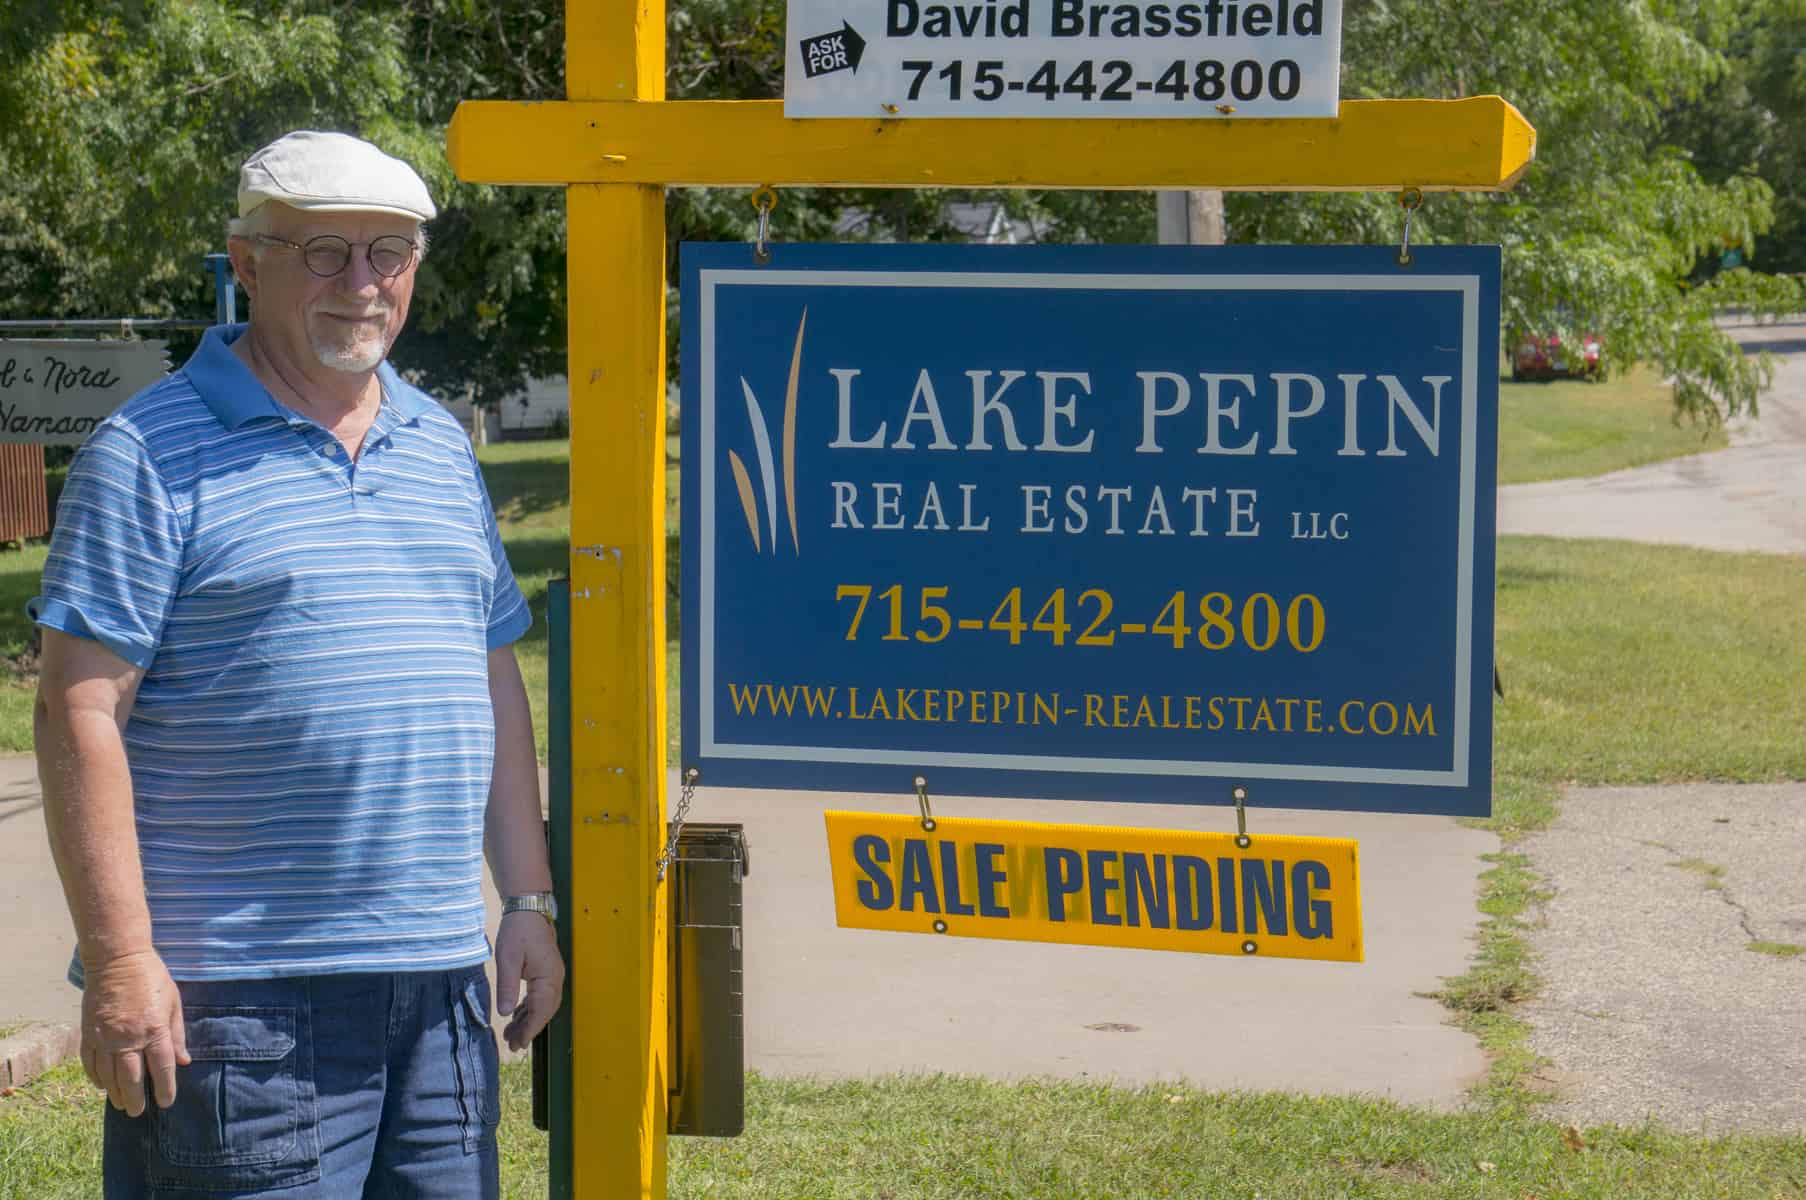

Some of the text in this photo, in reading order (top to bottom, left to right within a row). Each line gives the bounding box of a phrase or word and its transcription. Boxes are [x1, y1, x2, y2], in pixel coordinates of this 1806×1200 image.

[808, 35, 846, 58] ASK
[887, 0, 1323, 38] David Brassfield
[810, 51, 848, 73] FOR
[902, 60, 1300, 101] 715-442-4800
[828, 368, 1453, 457] LAKE PEPIN
[831, 481, 1350, 541] REAL ESTATE LLC
[835, 584, 1327, 652] 715-442-4800
[728, 683, 1439, 738] WWW.LAKEPEPIN-REALESTATE.COM
[852, 834, 1334, 940] SALE PENDING
